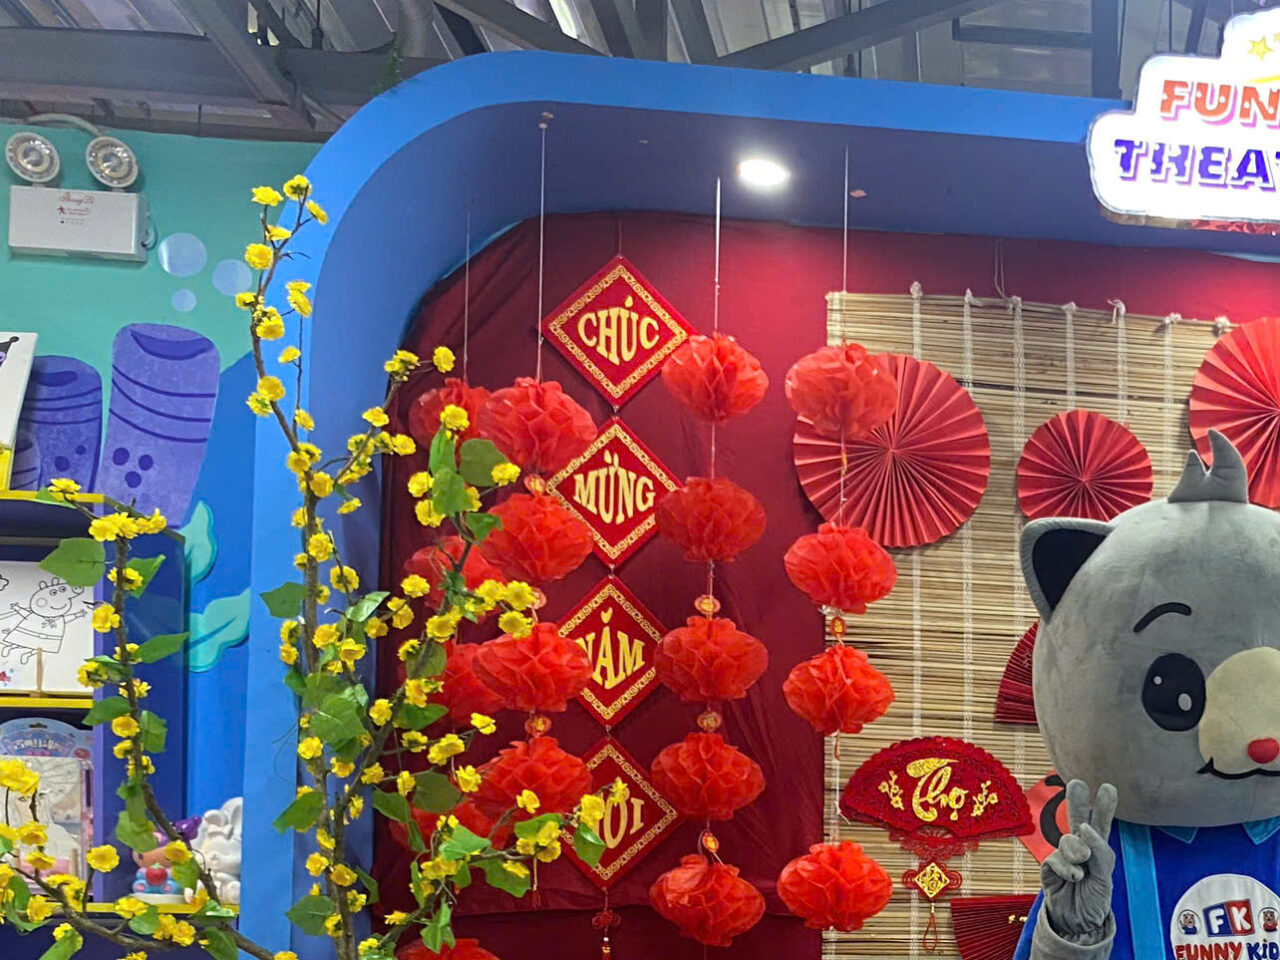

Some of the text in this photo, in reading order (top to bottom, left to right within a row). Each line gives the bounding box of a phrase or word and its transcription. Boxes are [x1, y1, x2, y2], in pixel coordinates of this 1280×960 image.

[577, 294, 660, 366] CHÚC
[573, 449, 656, 525] MỪNG
[1208, 906, 1251, 934] FK
